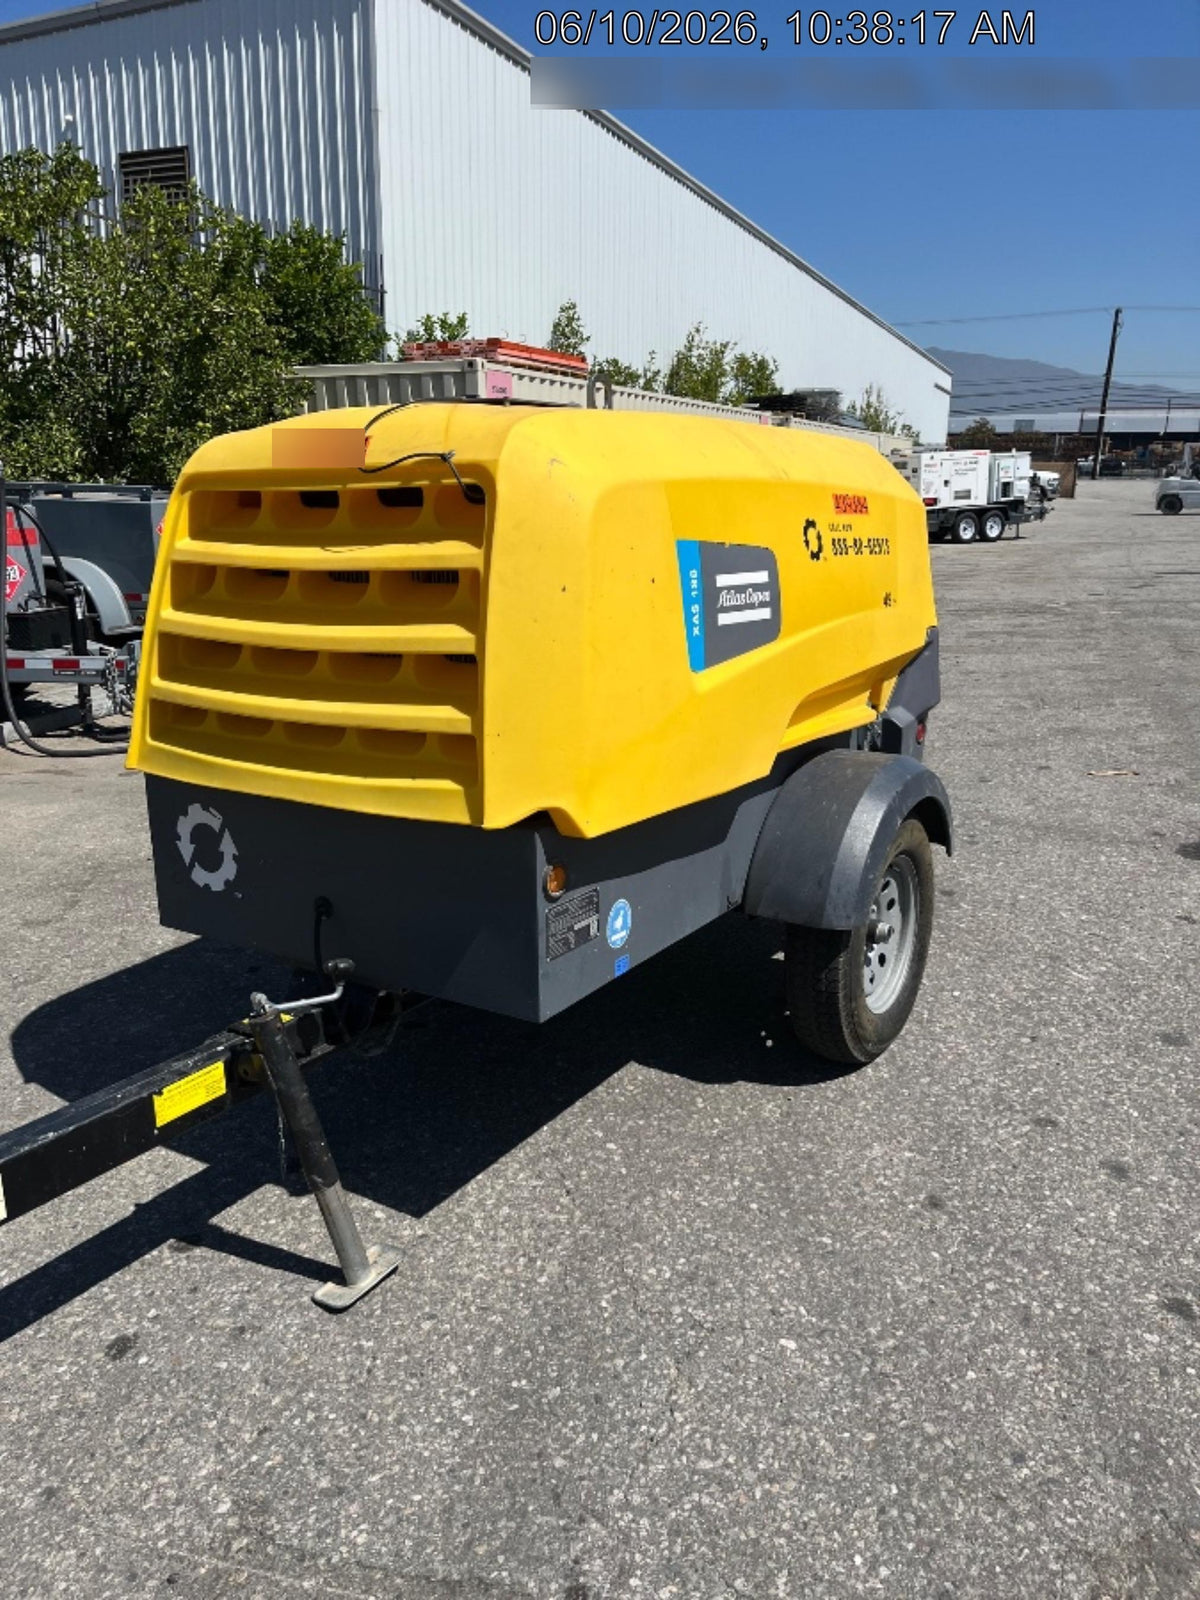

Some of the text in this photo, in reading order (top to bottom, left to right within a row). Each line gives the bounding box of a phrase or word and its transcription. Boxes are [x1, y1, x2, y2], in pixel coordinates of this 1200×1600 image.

[716, 588, 771, 608] Atlas Copco
[690, 604, 701, 637] XAS
